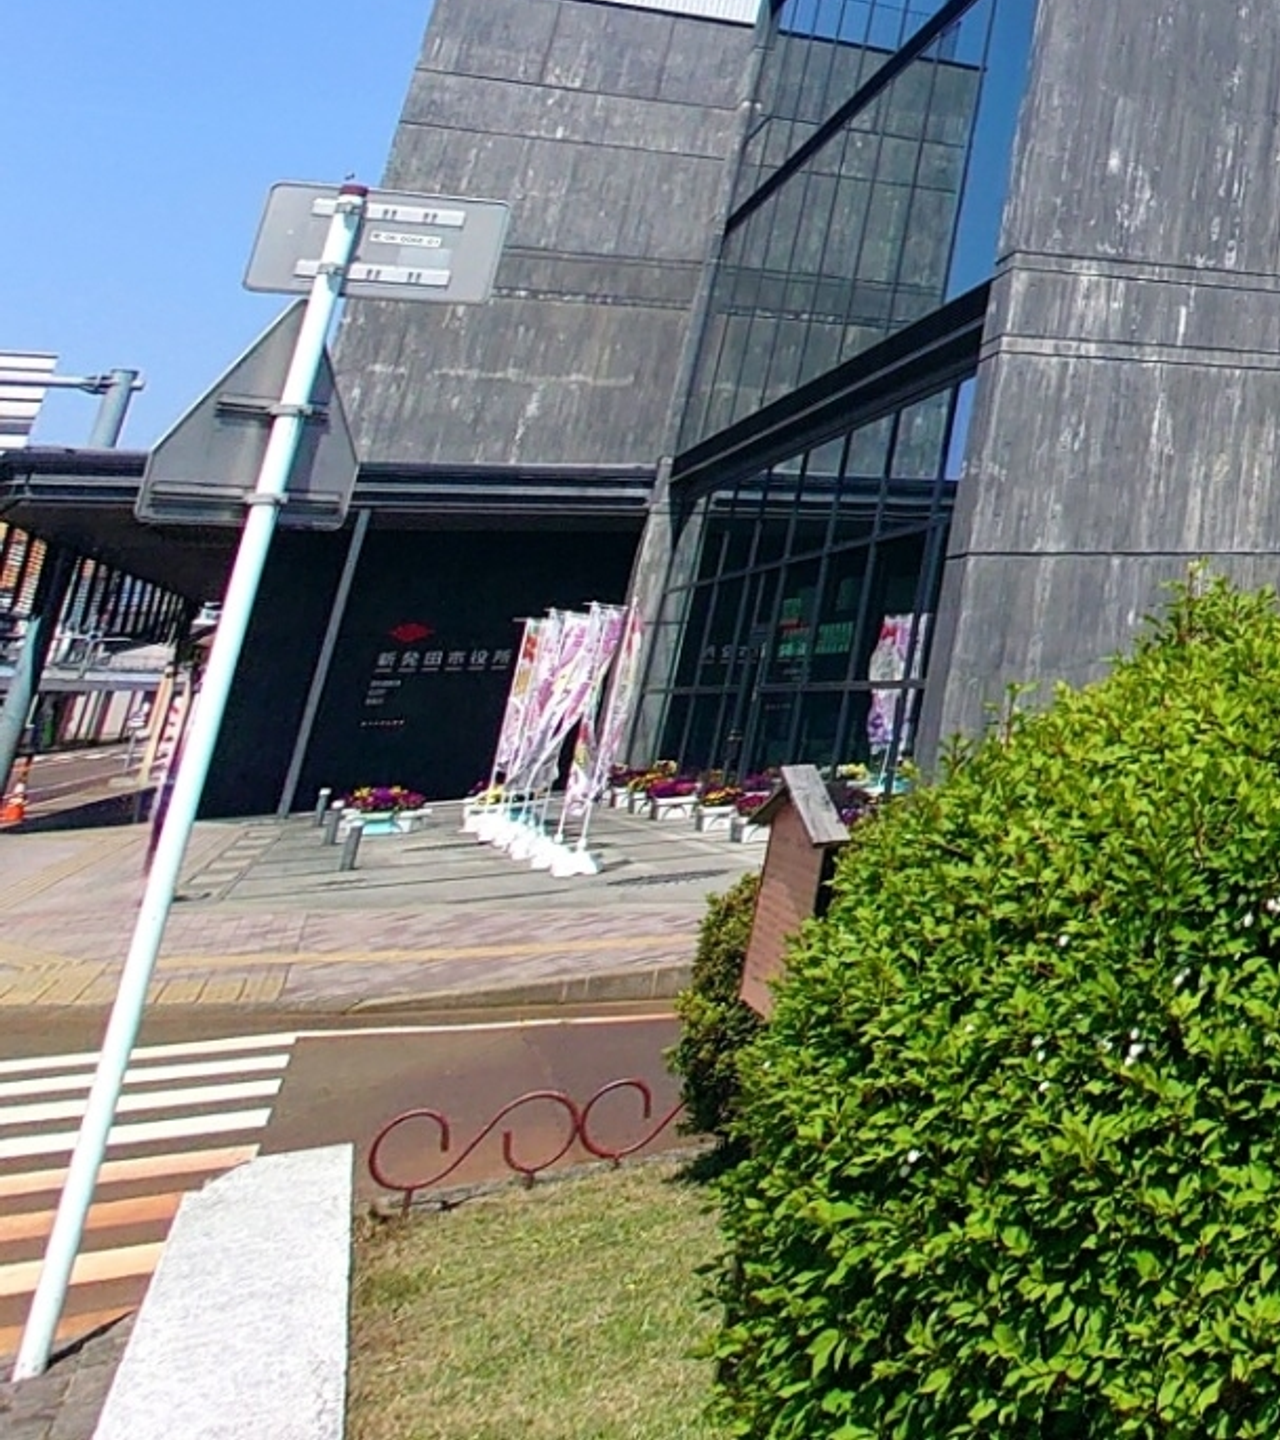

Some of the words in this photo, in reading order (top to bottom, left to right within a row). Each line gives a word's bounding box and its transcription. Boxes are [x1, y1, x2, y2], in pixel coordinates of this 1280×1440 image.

[376, 648, 513, 667] 新発田市役所
